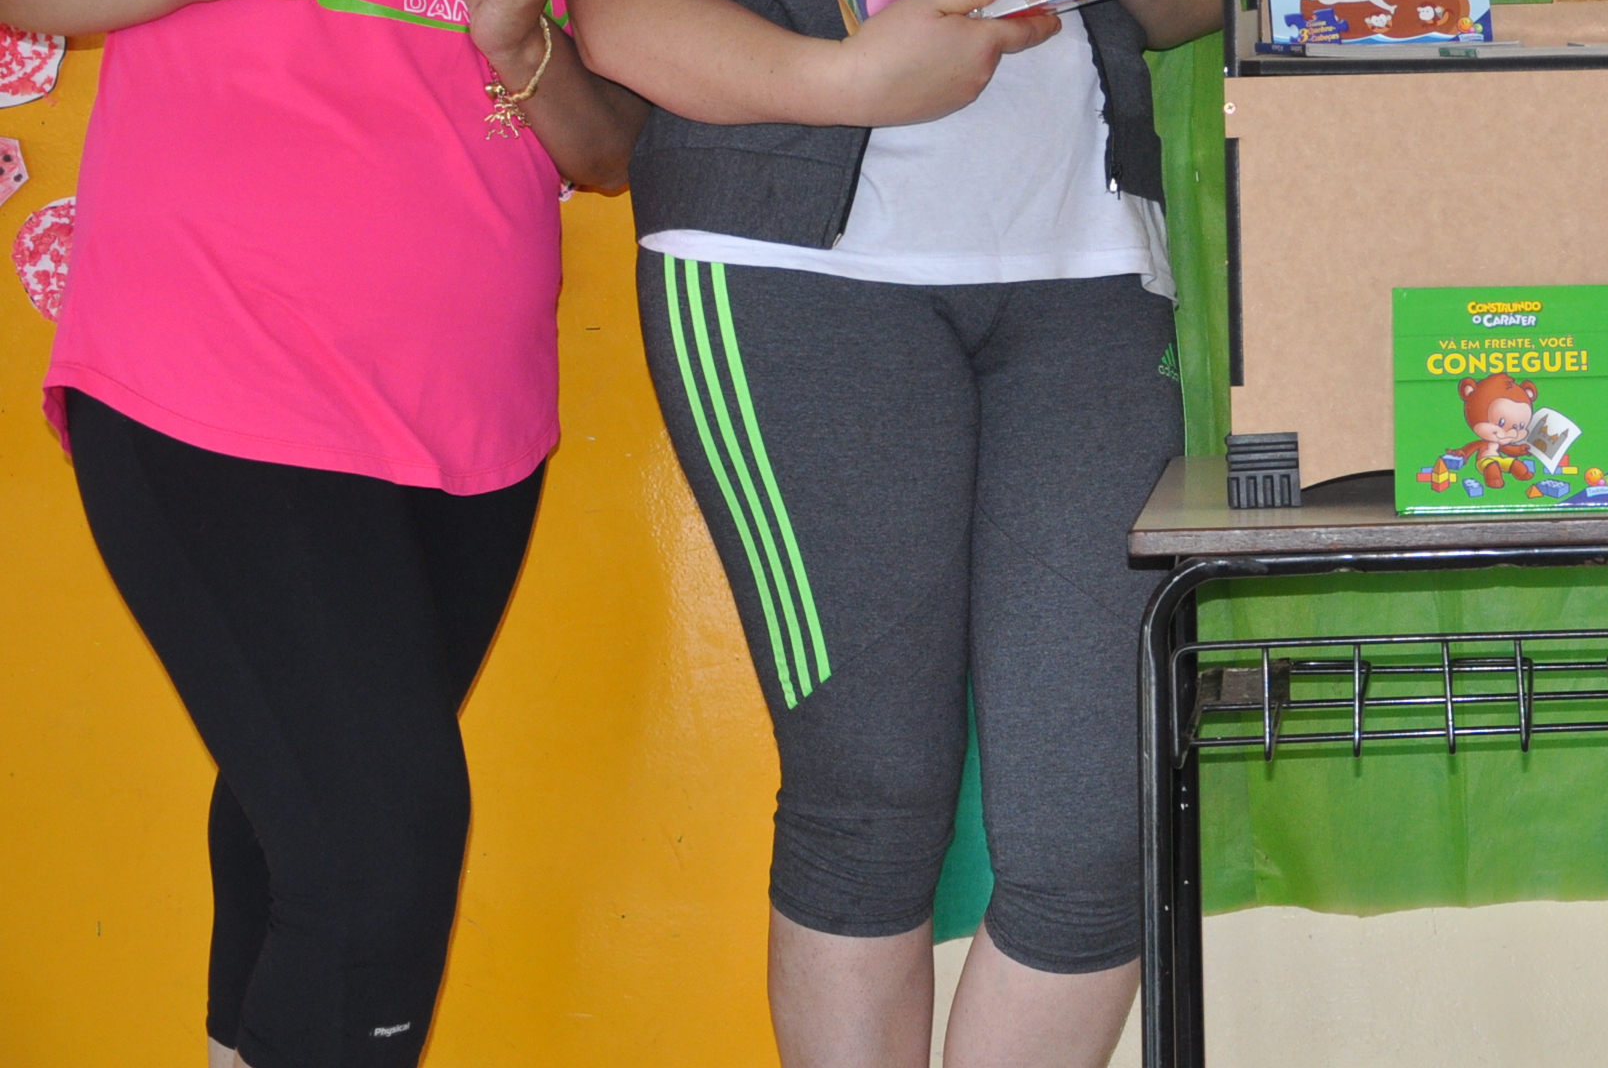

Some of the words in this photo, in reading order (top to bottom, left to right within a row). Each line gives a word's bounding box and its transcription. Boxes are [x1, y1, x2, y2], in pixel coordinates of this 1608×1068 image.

[1482, 311, 1537, 328] CARÁTER
[1439, 338, 1457, 350] VÁ
[1460, 339, 1481, 350] EM
[1484, 337, 1536, 350] FRENTE,
[1538, 334, 1574, 348] VOCÊ
[1426, 350, 1589, 376] CONSEGUE!
